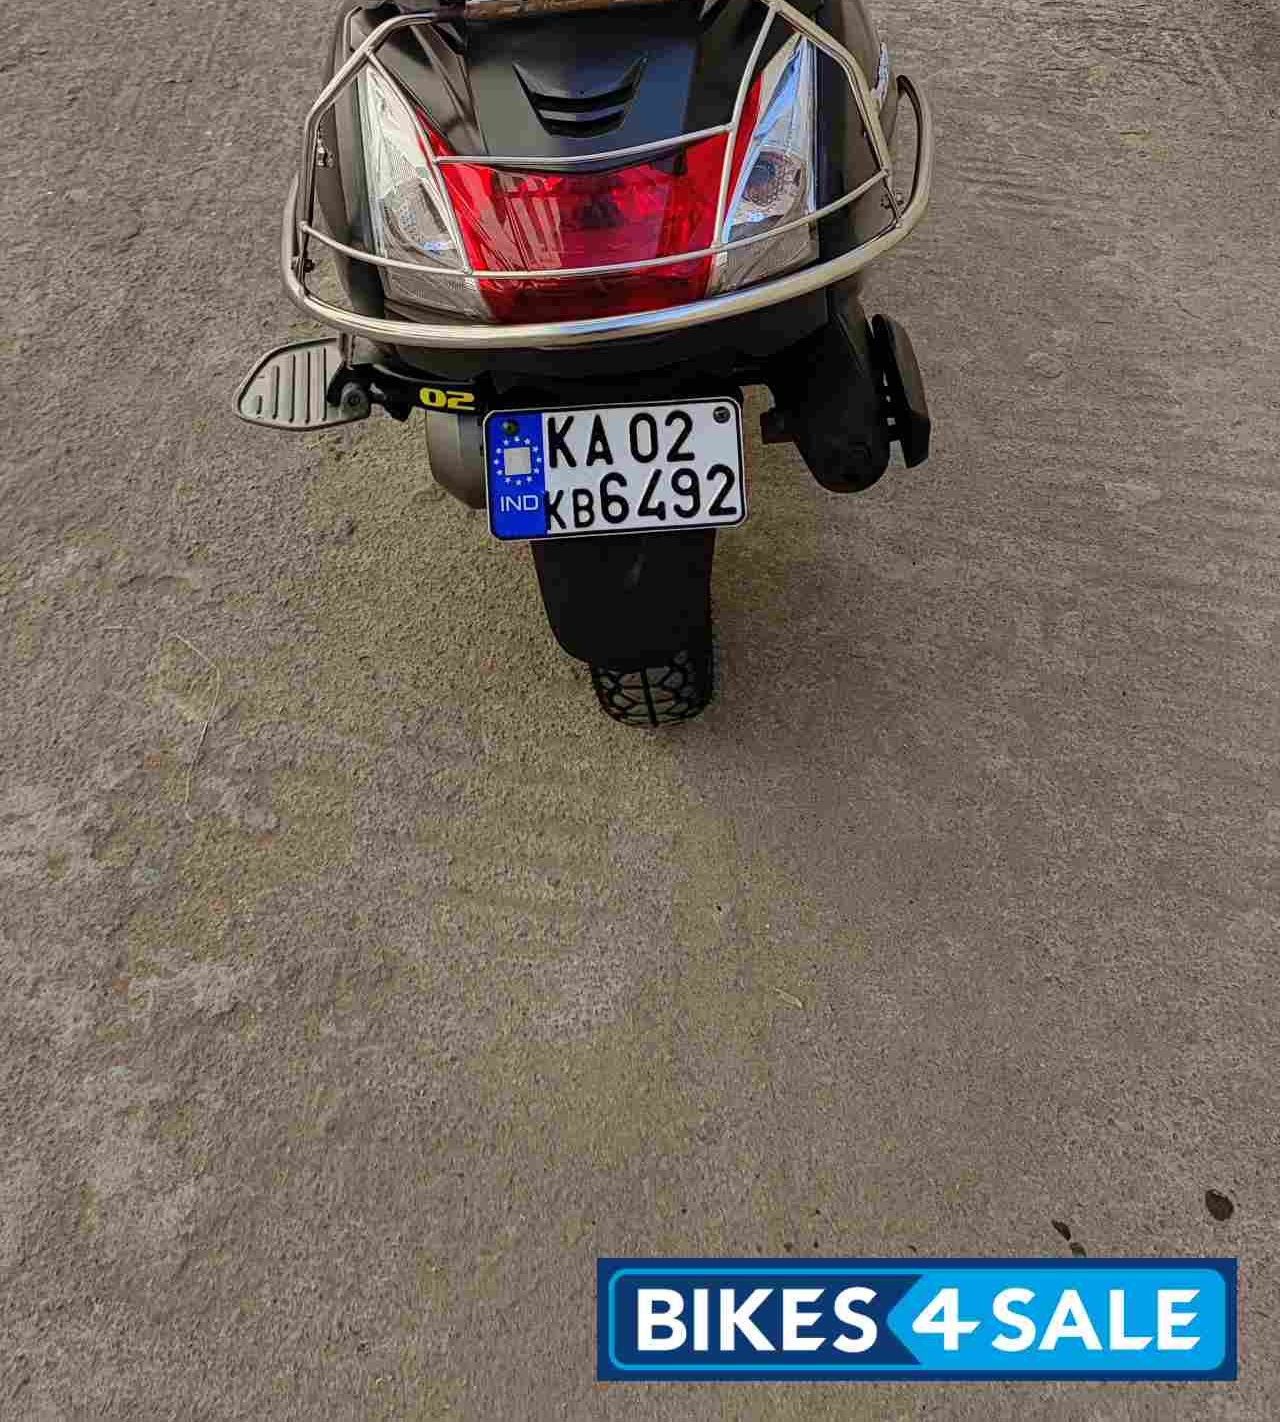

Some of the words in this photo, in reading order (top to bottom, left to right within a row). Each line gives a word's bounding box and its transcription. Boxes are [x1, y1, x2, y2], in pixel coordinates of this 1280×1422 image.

[547, 414, 614, 468] KA
[629, 410, 696, 464] 02
[500, 495, 539, 512] IND
